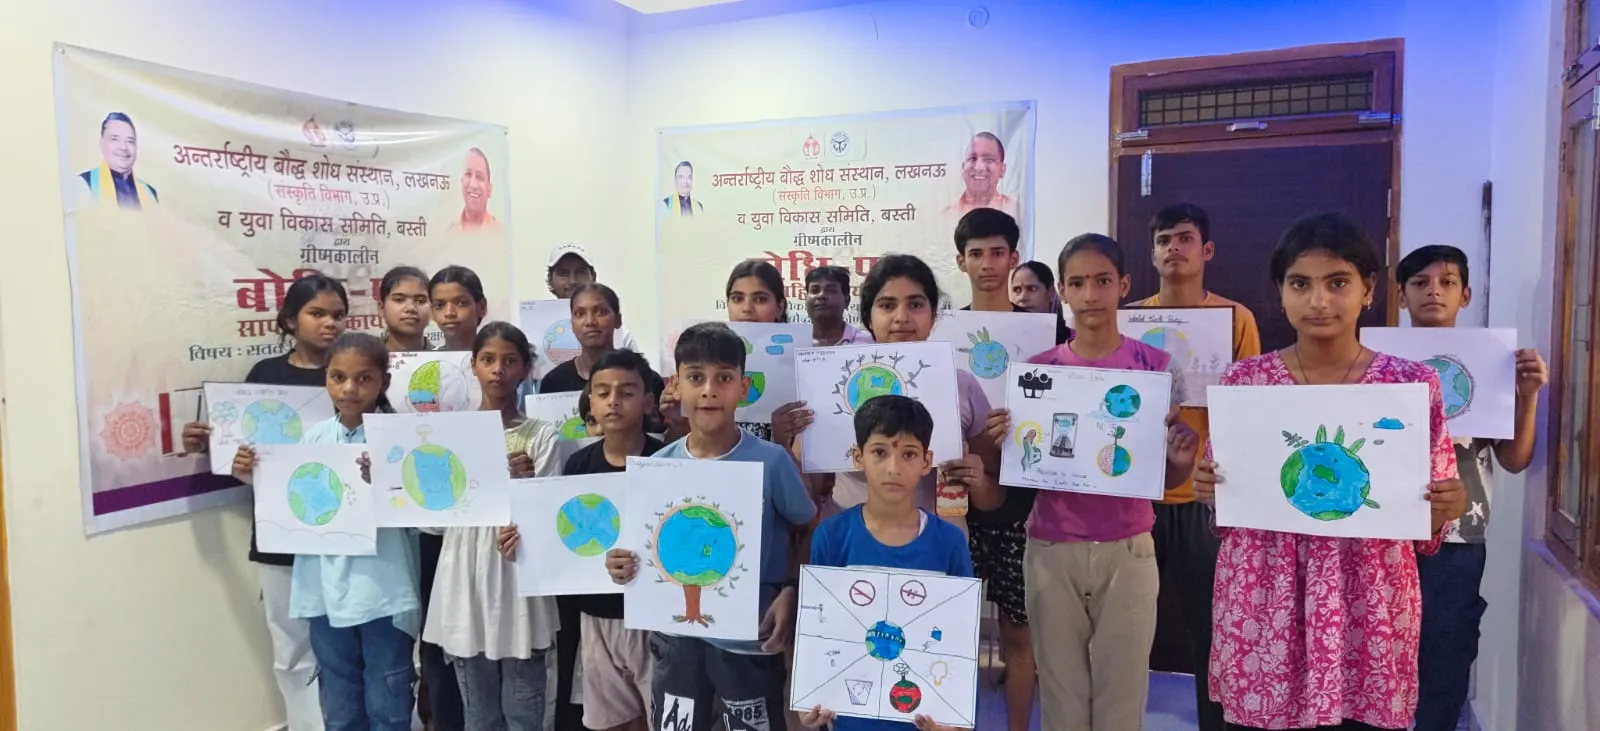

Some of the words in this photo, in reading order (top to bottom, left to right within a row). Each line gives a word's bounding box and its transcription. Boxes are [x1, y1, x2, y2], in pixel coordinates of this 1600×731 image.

[173, 141, 268, 178] अन्तर्राष्ट्रीय
[273, 149, 307, 180] बौद्ध
[312, 154, 342, 182] शोध
[346, 159, 400, 190] संस्थान,
[402, 171, 450, 190] लखनऊ
[712, 166, 776, 190] अन्तर्राष्ट्रीय
[779, 165, 805, 186] बौद्ध
[810, 164, 834, 183] शोध
[839, 162, 889, 183] संस्थान,
[895, 163, 947, 180] लखनऊ
[217, 210, 232, 228] व
[238, 211, 273, 238] युवा
[280, 207, 333, 233] विकास
[338, 211, 391, 239] समिति,
[737, 213, 746, 224] व
[750, 212, 774, 230] युवा
[779, 207, 821, 225] विकास
[826, 205, 875, 223] समिति,
[881, 203, 916, 221] बस्ती
[300, 244, 380, 264] ग्रीष्मकालीन
[189, 345, 232, 361] विषय
